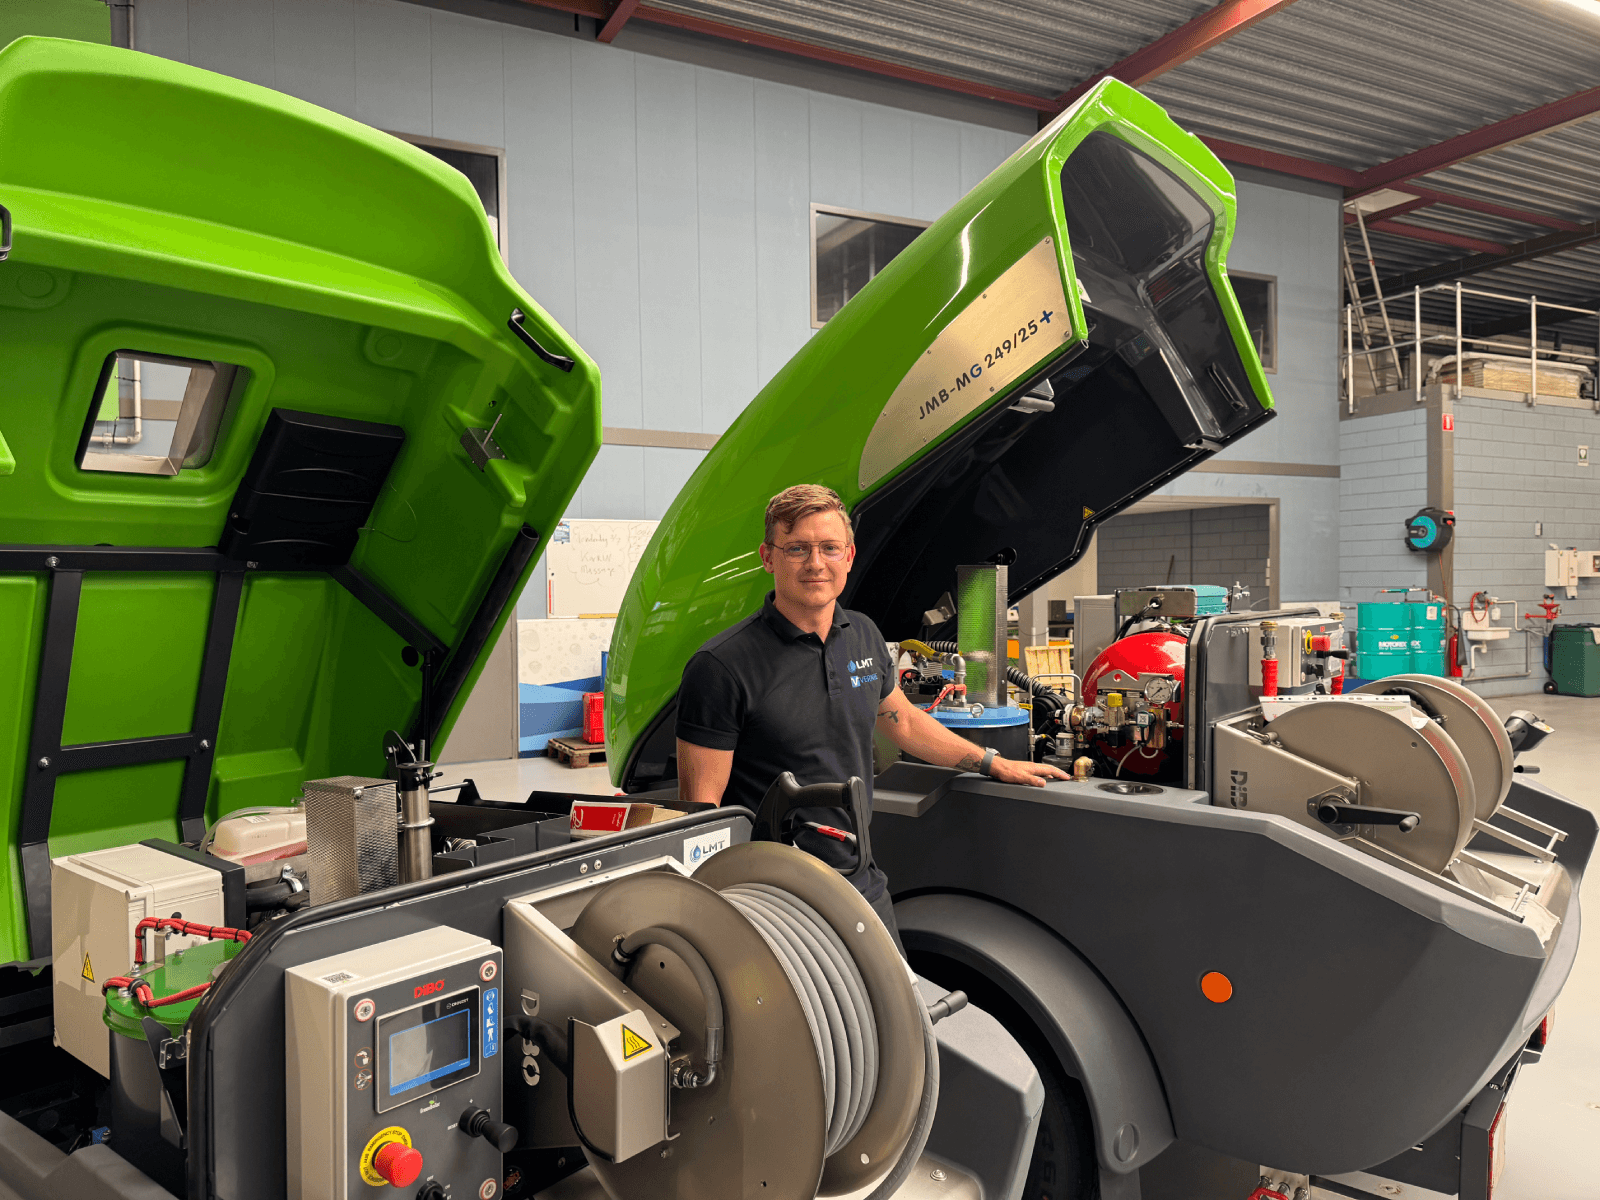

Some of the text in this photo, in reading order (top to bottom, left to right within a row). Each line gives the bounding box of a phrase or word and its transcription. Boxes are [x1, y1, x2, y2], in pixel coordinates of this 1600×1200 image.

[918, 363, 982, 420] JMB-MG
[855, 657, 873, 670] LMT
[1230, 770, 1248, 808] DiB
[702, 840, 726, 855] LMT
